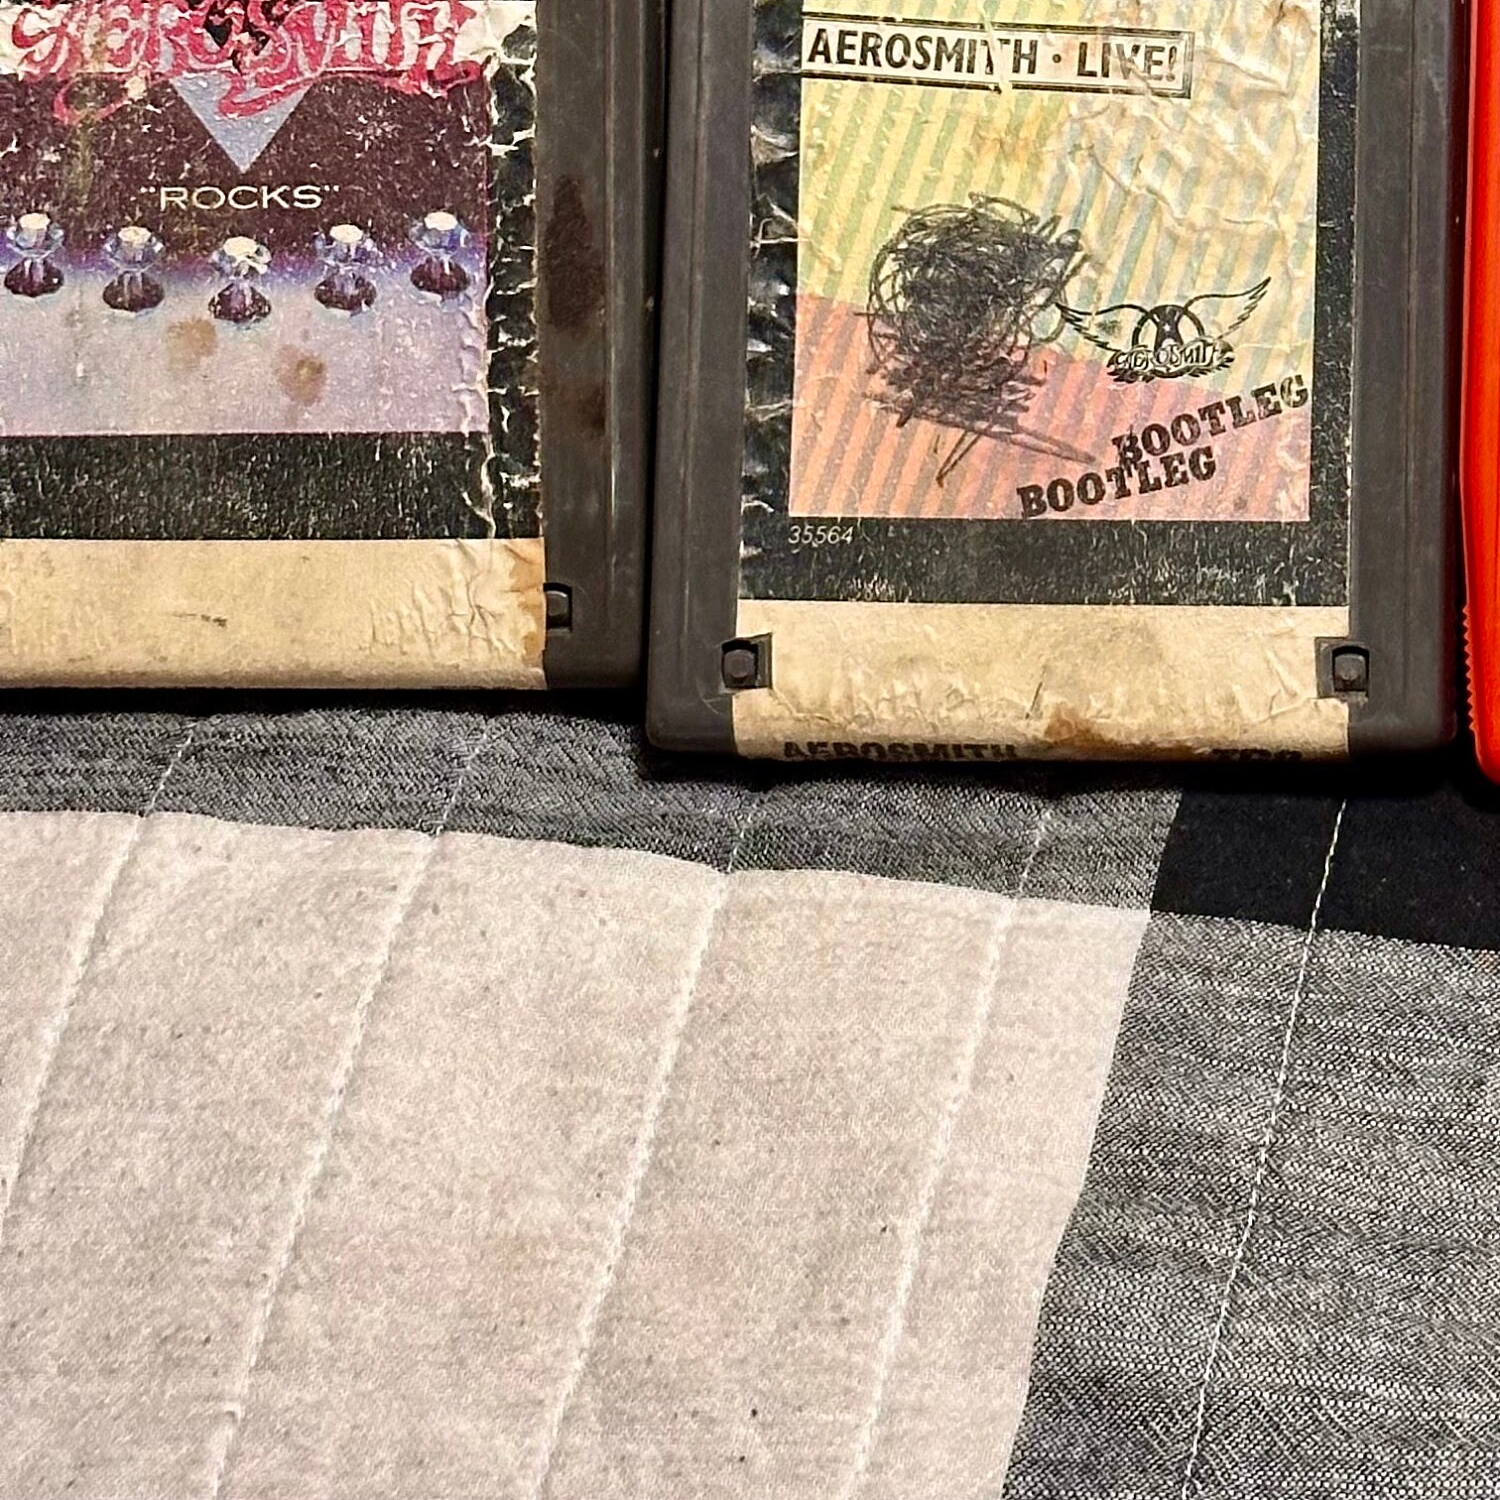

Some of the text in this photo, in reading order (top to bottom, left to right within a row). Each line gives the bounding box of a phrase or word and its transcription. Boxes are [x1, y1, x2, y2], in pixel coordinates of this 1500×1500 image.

[808, 27, 1178, 83] AEROSMITH LIVE!
[1112, 374, 1309, 469] BOOTLEG
[1016, 446, 1217, 520] BOOTLEG
[788, 523, 853, 547] 35564
